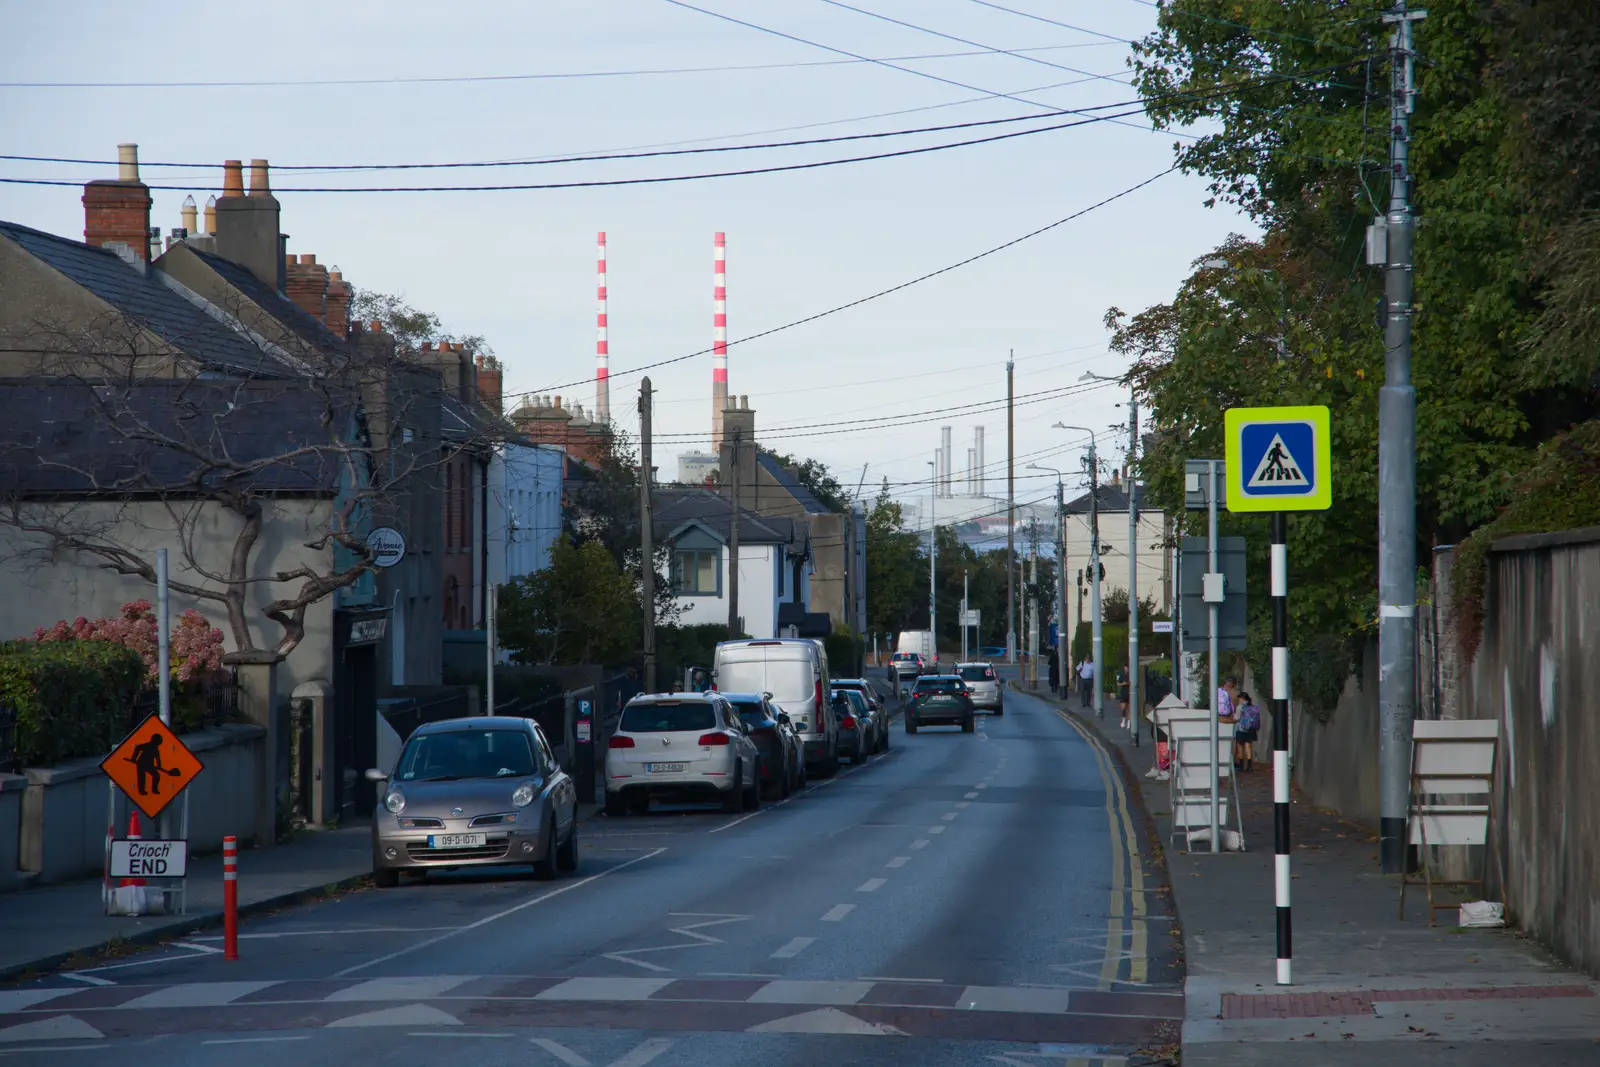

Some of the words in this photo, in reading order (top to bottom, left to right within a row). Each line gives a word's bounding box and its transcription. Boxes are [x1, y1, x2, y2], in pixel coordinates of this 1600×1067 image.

[371, 537, 403, 550] Avenue
[581, 701, 589, 712] P
[442, 835, 477, 845] 09-D-1071
[129, 843, 170, 857] Críoch
[129, 859, 167, 874] END
